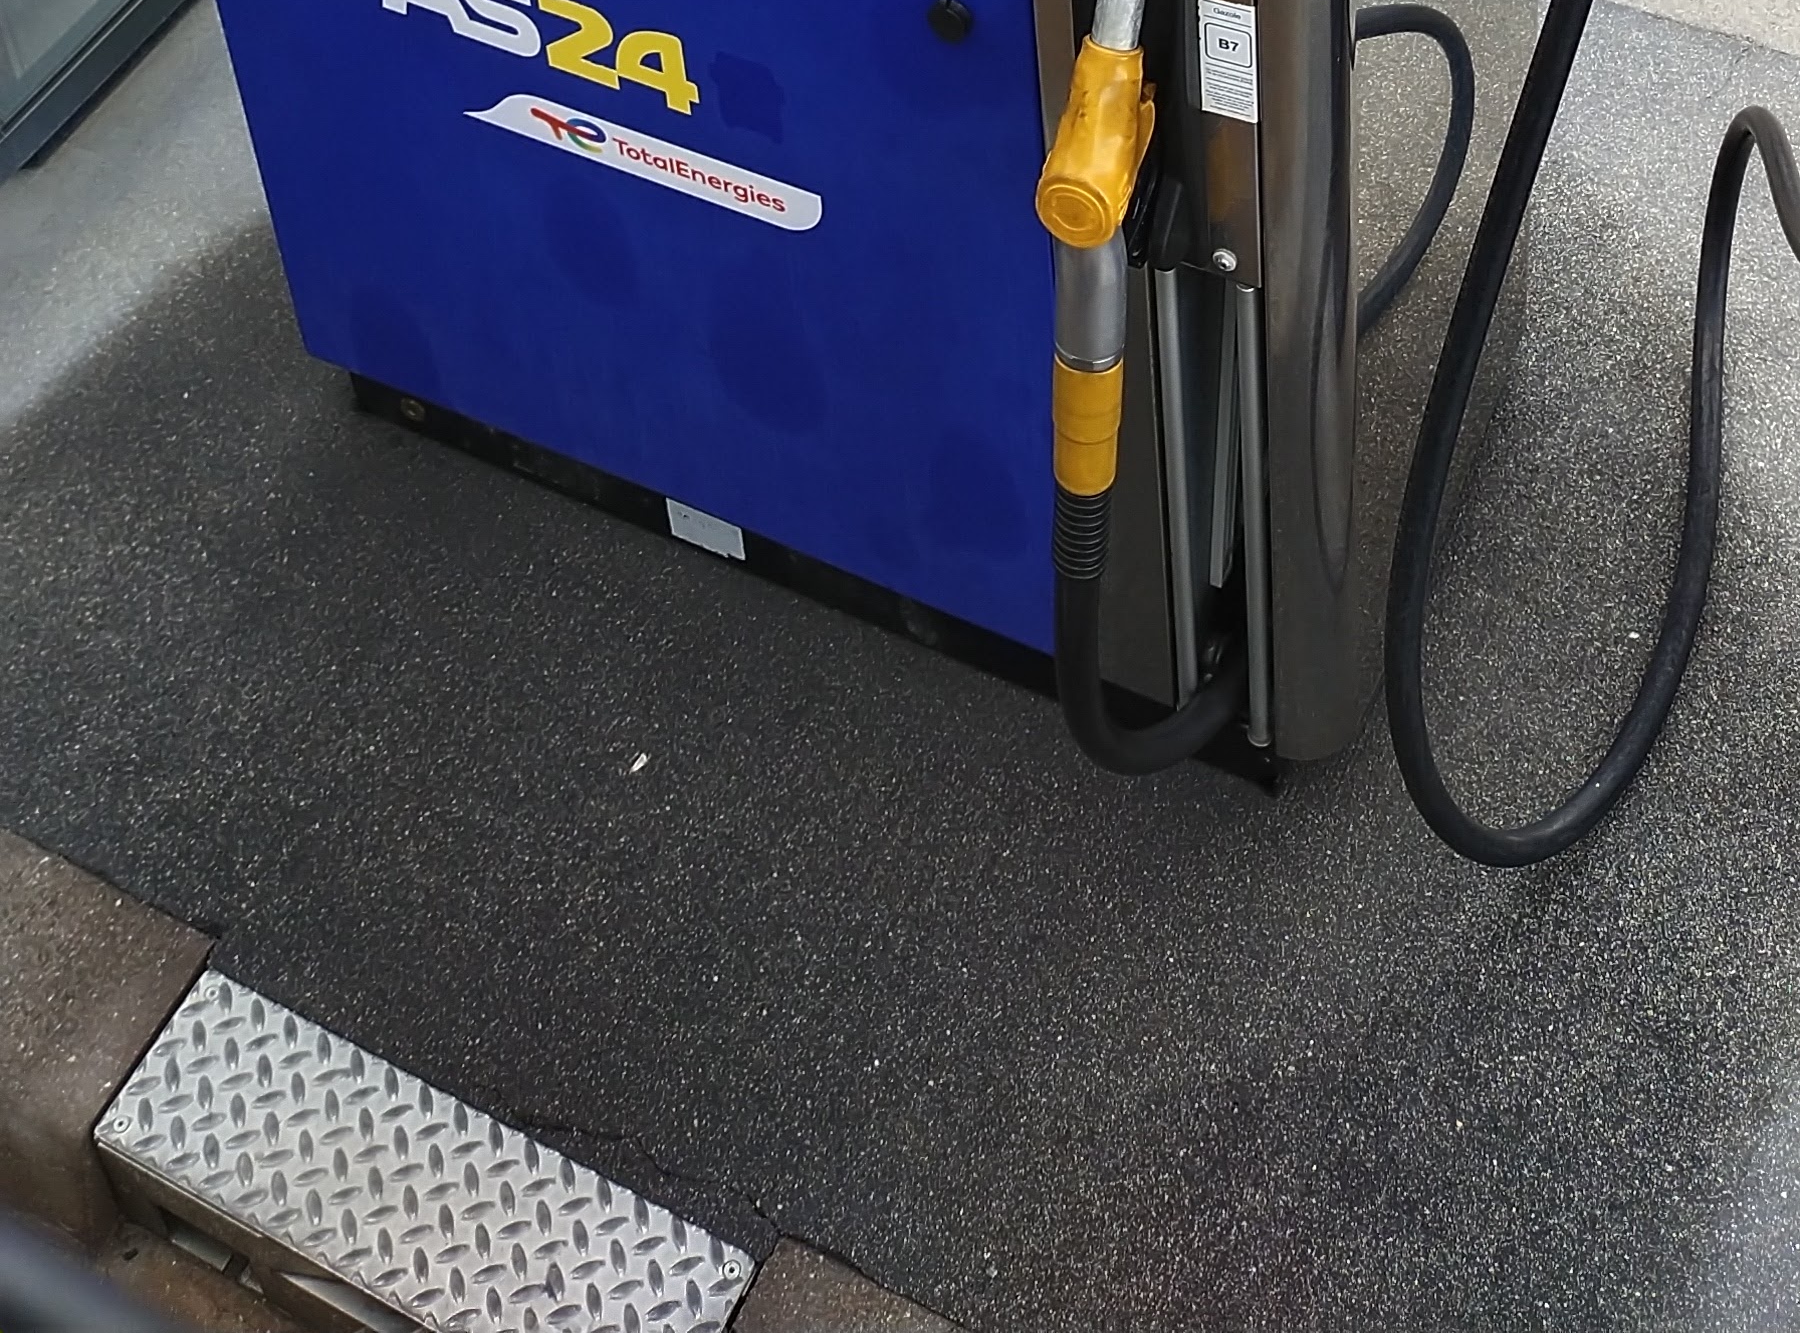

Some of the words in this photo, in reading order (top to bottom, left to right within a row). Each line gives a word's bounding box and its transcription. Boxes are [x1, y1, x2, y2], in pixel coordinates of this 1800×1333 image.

[1213, 7, 1242, 20] Gazole
[1218, 38, 1239, 52] B7
[612, 136, 787, 213] TotalEnergies
